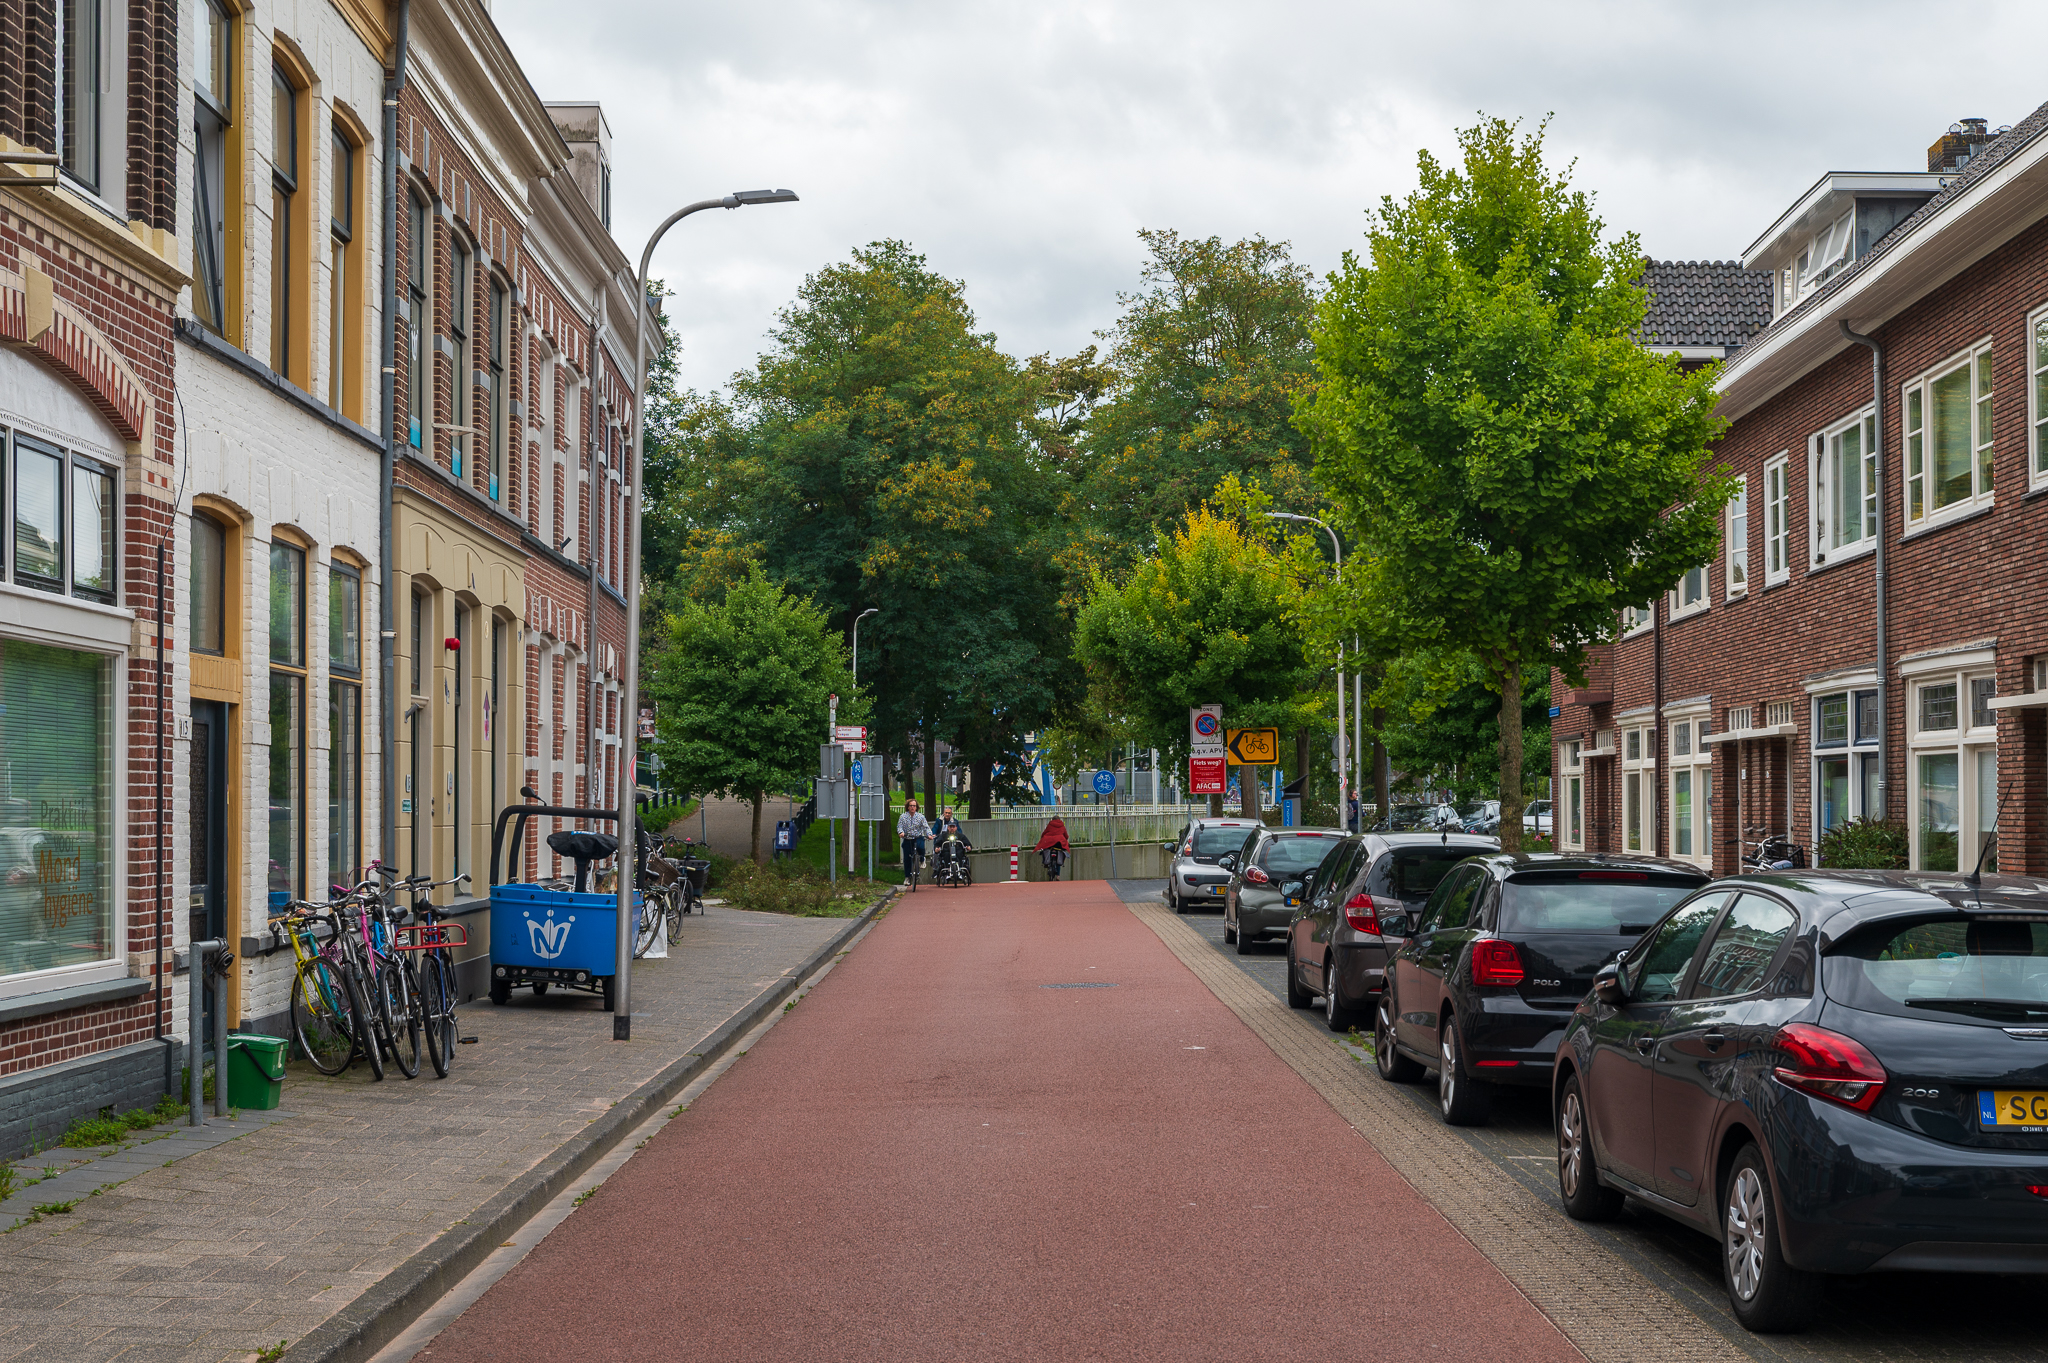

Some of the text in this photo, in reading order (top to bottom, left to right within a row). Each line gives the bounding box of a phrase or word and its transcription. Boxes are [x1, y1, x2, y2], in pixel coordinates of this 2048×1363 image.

[1244, 735, 1249, 743] 1
[1207, 759, 1222, 767] weg?
[41, 798, 88, 840] Praktijk
[54, 834, 74, 852] voor
[39, 845, 81, 884] Mond
[44, 886, 93, 929] hygiëne
[1902, 1087, 1939, 1099] 208
[1982, 1111, 1994, 1119] NL
